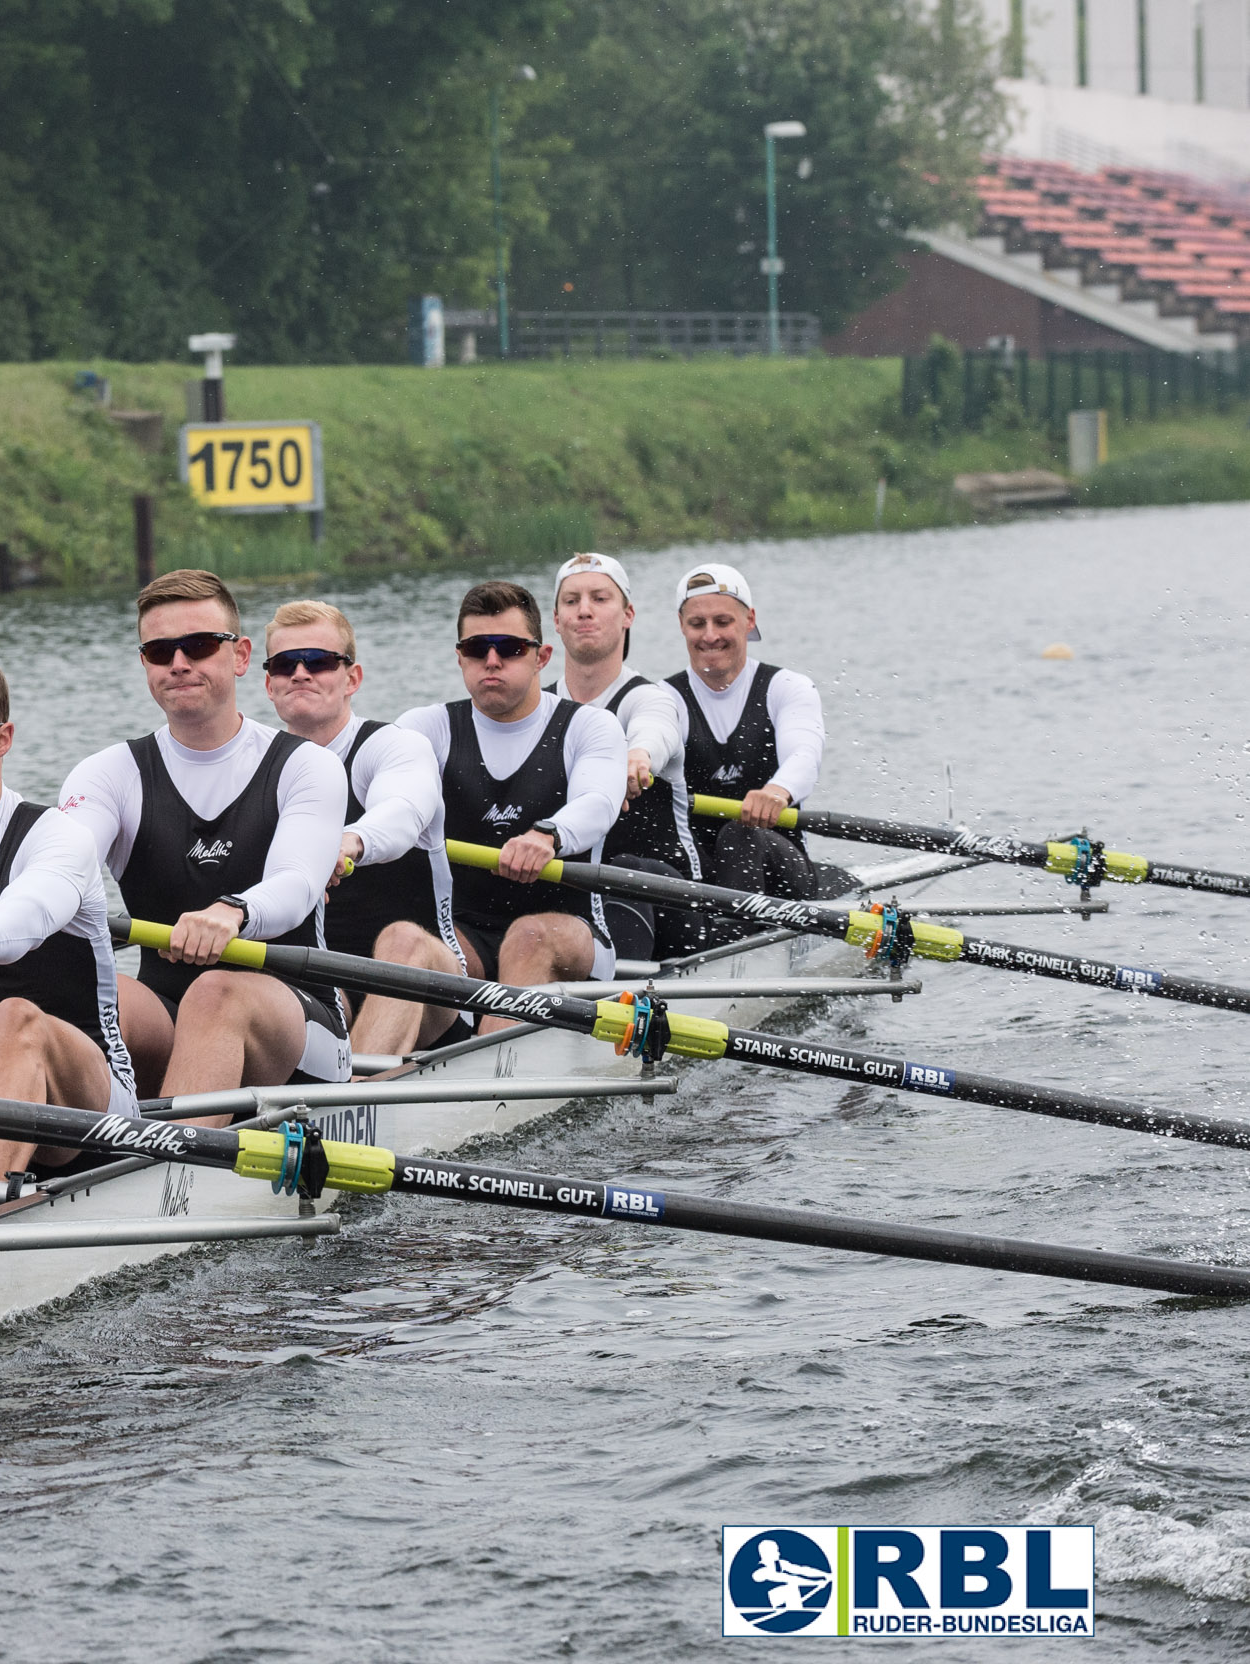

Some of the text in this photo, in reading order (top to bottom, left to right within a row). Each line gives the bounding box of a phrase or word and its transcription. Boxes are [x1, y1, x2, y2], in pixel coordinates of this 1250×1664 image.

[189, 440, 302, 491] 1750
[1121, 969, 1157, 987] RBL
[733, 1037, 898, 1079] STARK. SCHNELL. GUT.
[911, 1066, 950, 1087] RBL
[402, 1166, 598, 1207] STARK. SCHNELL. GUT.
[612, 1191, 659, 1213] RBL
